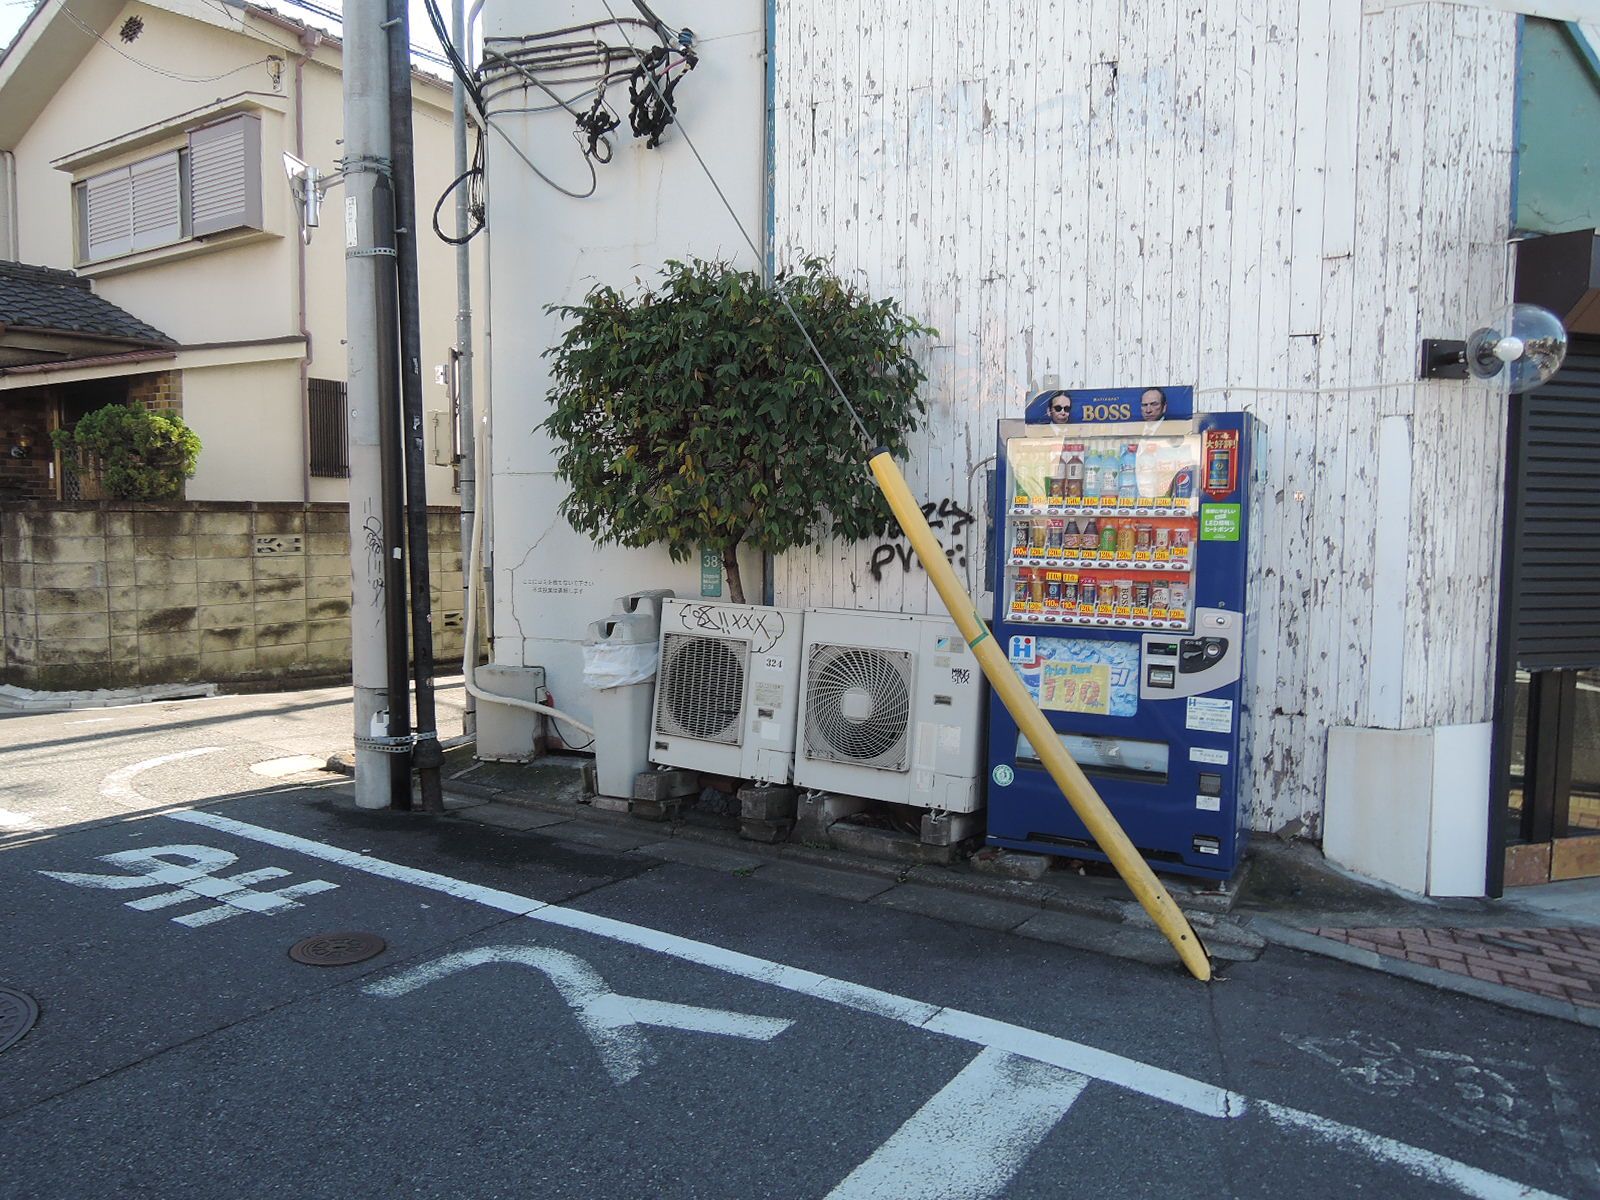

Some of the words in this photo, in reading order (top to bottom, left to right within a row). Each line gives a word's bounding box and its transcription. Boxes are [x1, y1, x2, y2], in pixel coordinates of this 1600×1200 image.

[1082, 404, 1131, 422] BOSS
[703, 556, 718, 568] 38
[1139, 588, 1147, 608] BLAC
[766, 658, 783, 668] 324
